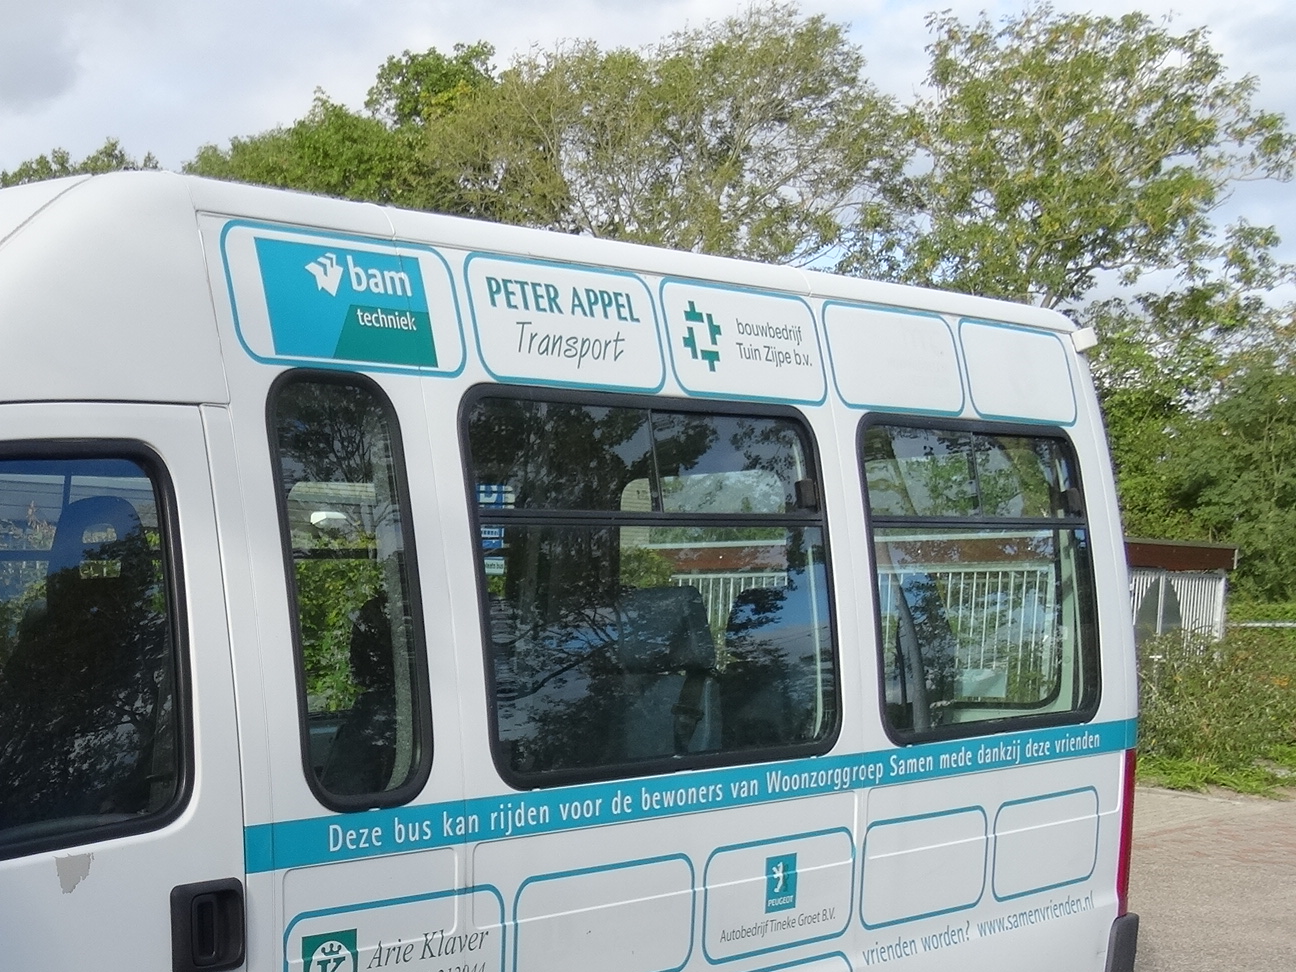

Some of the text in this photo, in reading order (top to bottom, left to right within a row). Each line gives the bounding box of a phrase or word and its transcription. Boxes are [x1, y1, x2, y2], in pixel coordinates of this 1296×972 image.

[346, 255, 413, 297] bam
[356, 308, 417, 331] techniek
[485, 276, 641, 323] PETER APPEL
[516, 321, 625, 369] Transport
[735, 318, 803, 346] bouwbedrijf
[735, 342, 813, 367] Tuin Zijpe b.v.
[328, 731, 1101, 853] Deze bus kan rijden voor de bewoners van Woonzorggroep Samen mede dankzij deze vrienden
[768, 895, 794, 907] PEUGEOT
[720, 907, 836, 943] Autobedrijf Tineke Groet B.V.
[862, 890, 1095, 966] vrienden worden? www.samenvrienden.nl
[367, 929, 489, 969] Arie Klaver
